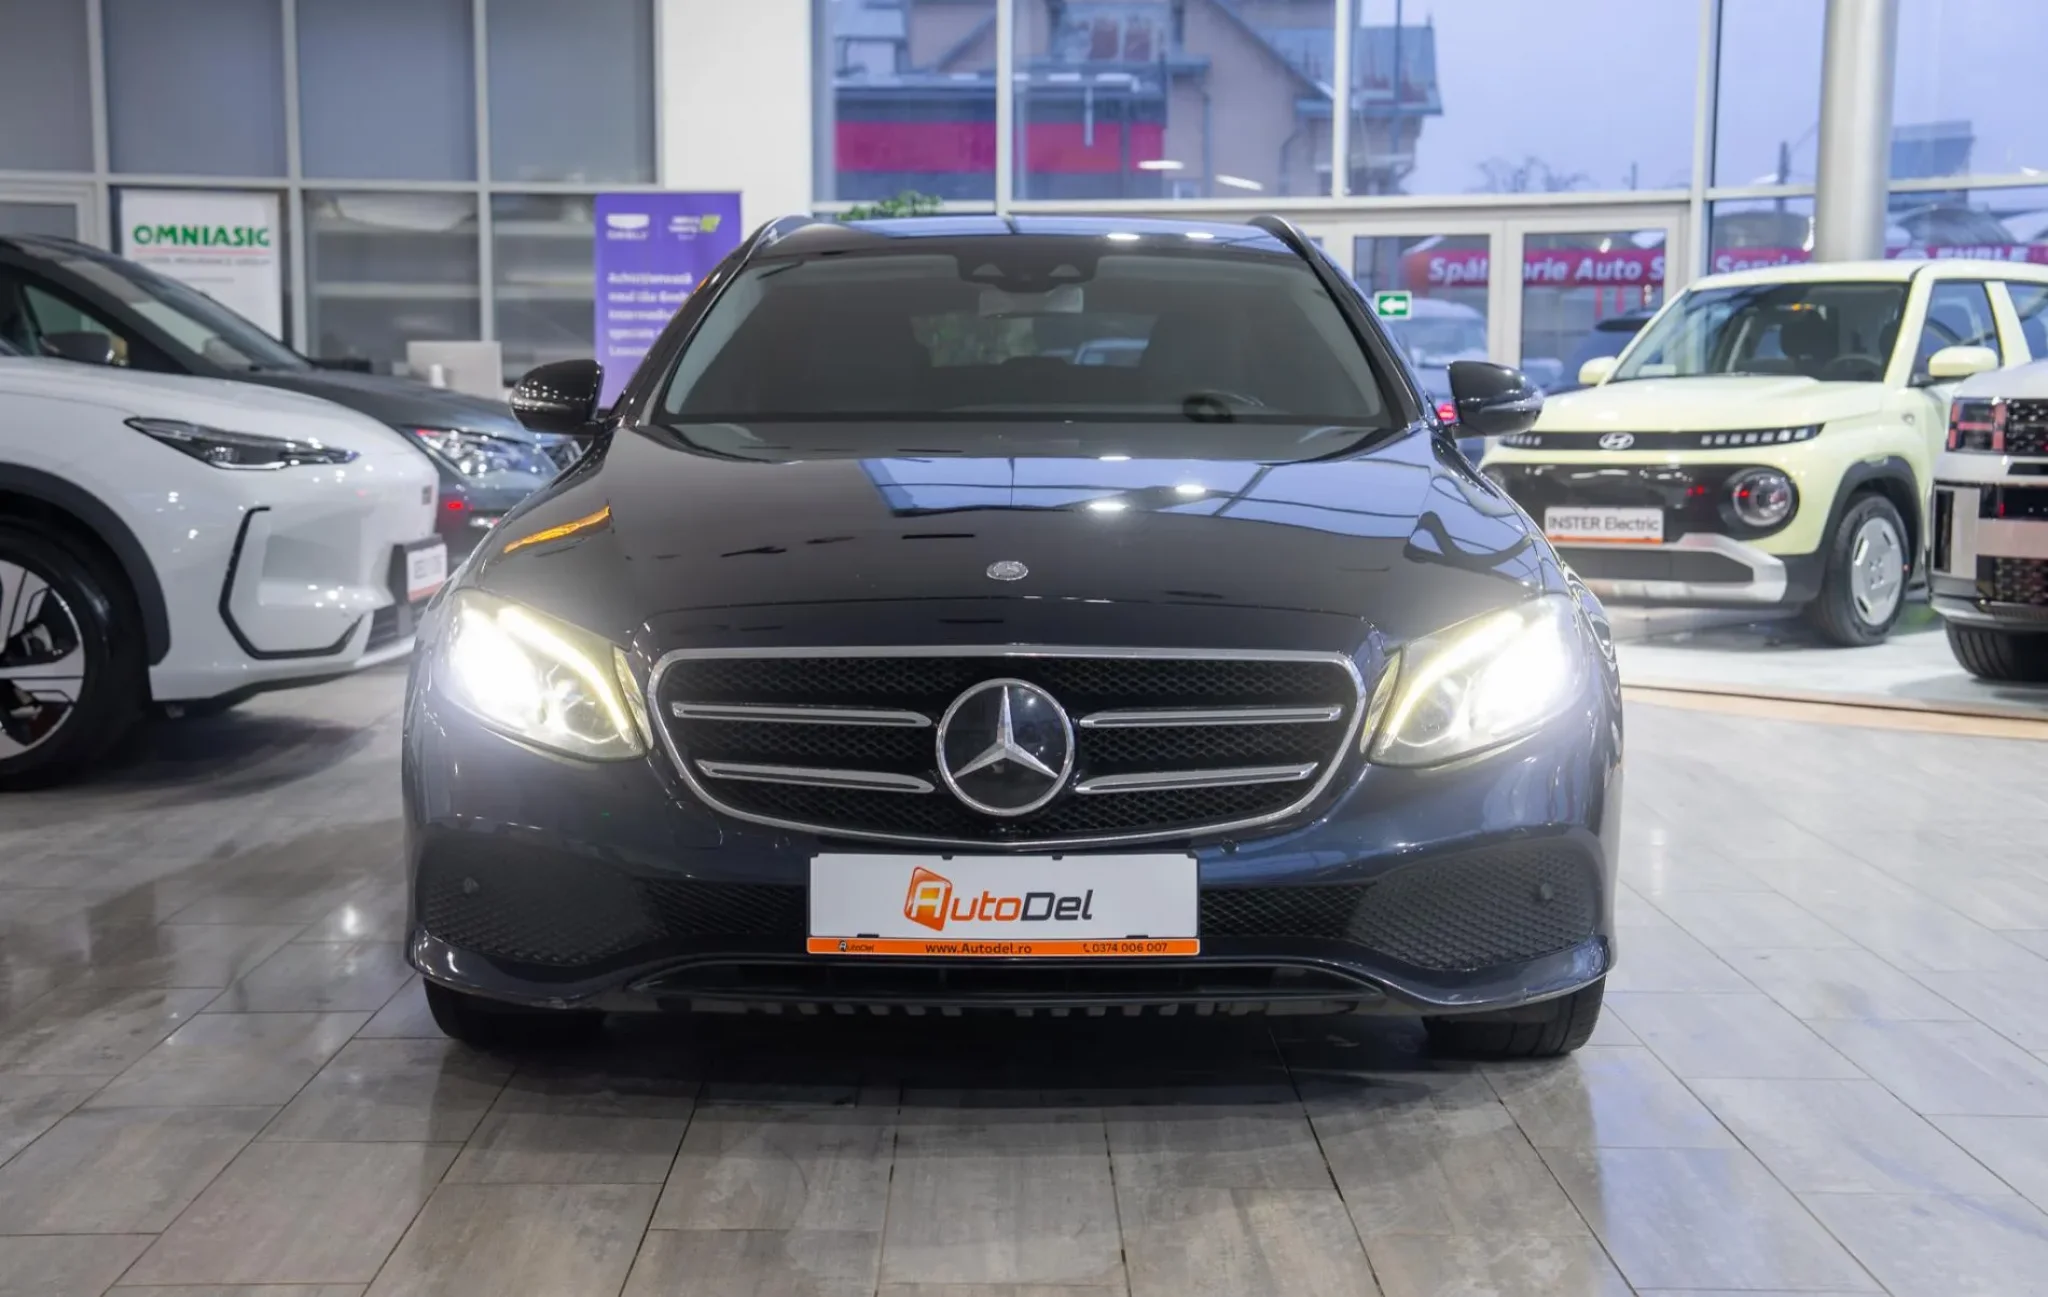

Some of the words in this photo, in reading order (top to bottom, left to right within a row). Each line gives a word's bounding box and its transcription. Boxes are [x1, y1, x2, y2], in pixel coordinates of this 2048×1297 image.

[132, 225, 271, 247] OMNIASIG
[1575, 257, 1642, 281] Auto
[1548, 516, 1601, 530] INSTER
[1604, 516, 1659, 531] Electric
[906, 873, 1093, 927] AutoDel
[925, 942, 1032, 955] www.Autodel.ro
[1092, 942, 1118, 953] 0374
[1121, 942, 1144, 953] 006
[1146, 941, 1168, 952] 007
